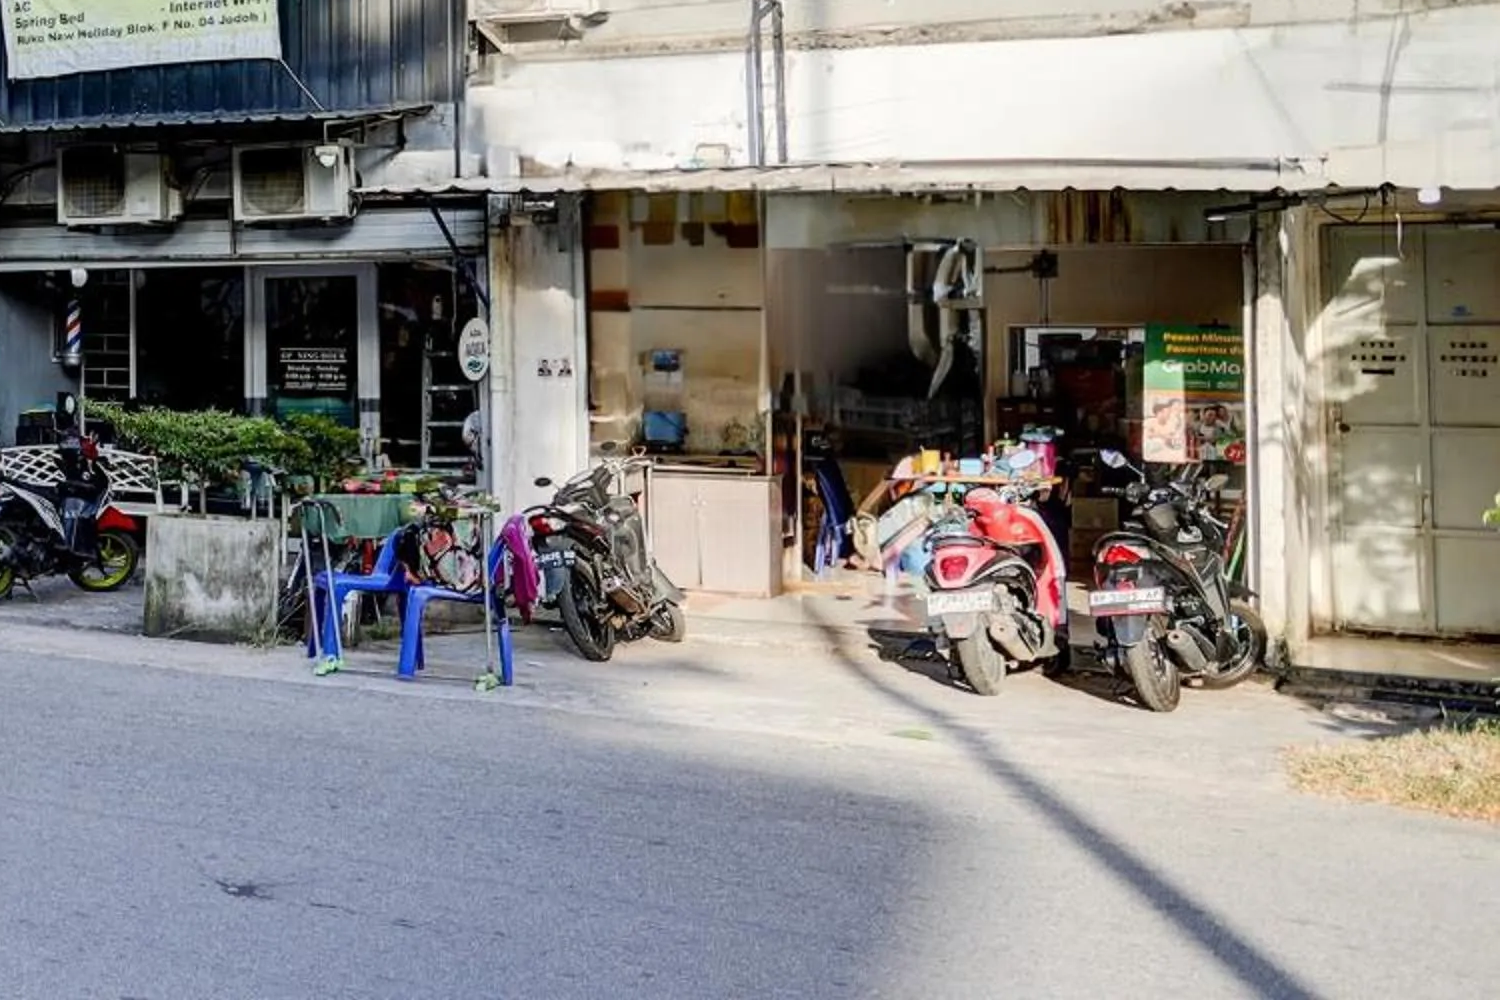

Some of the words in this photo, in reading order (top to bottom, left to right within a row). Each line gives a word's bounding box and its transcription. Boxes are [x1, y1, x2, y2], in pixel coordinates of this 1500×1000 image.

[14, 1, 31, 13] AC
[15, 15, 56, 30] Spring
[60, 12, 85, 25] Bed
